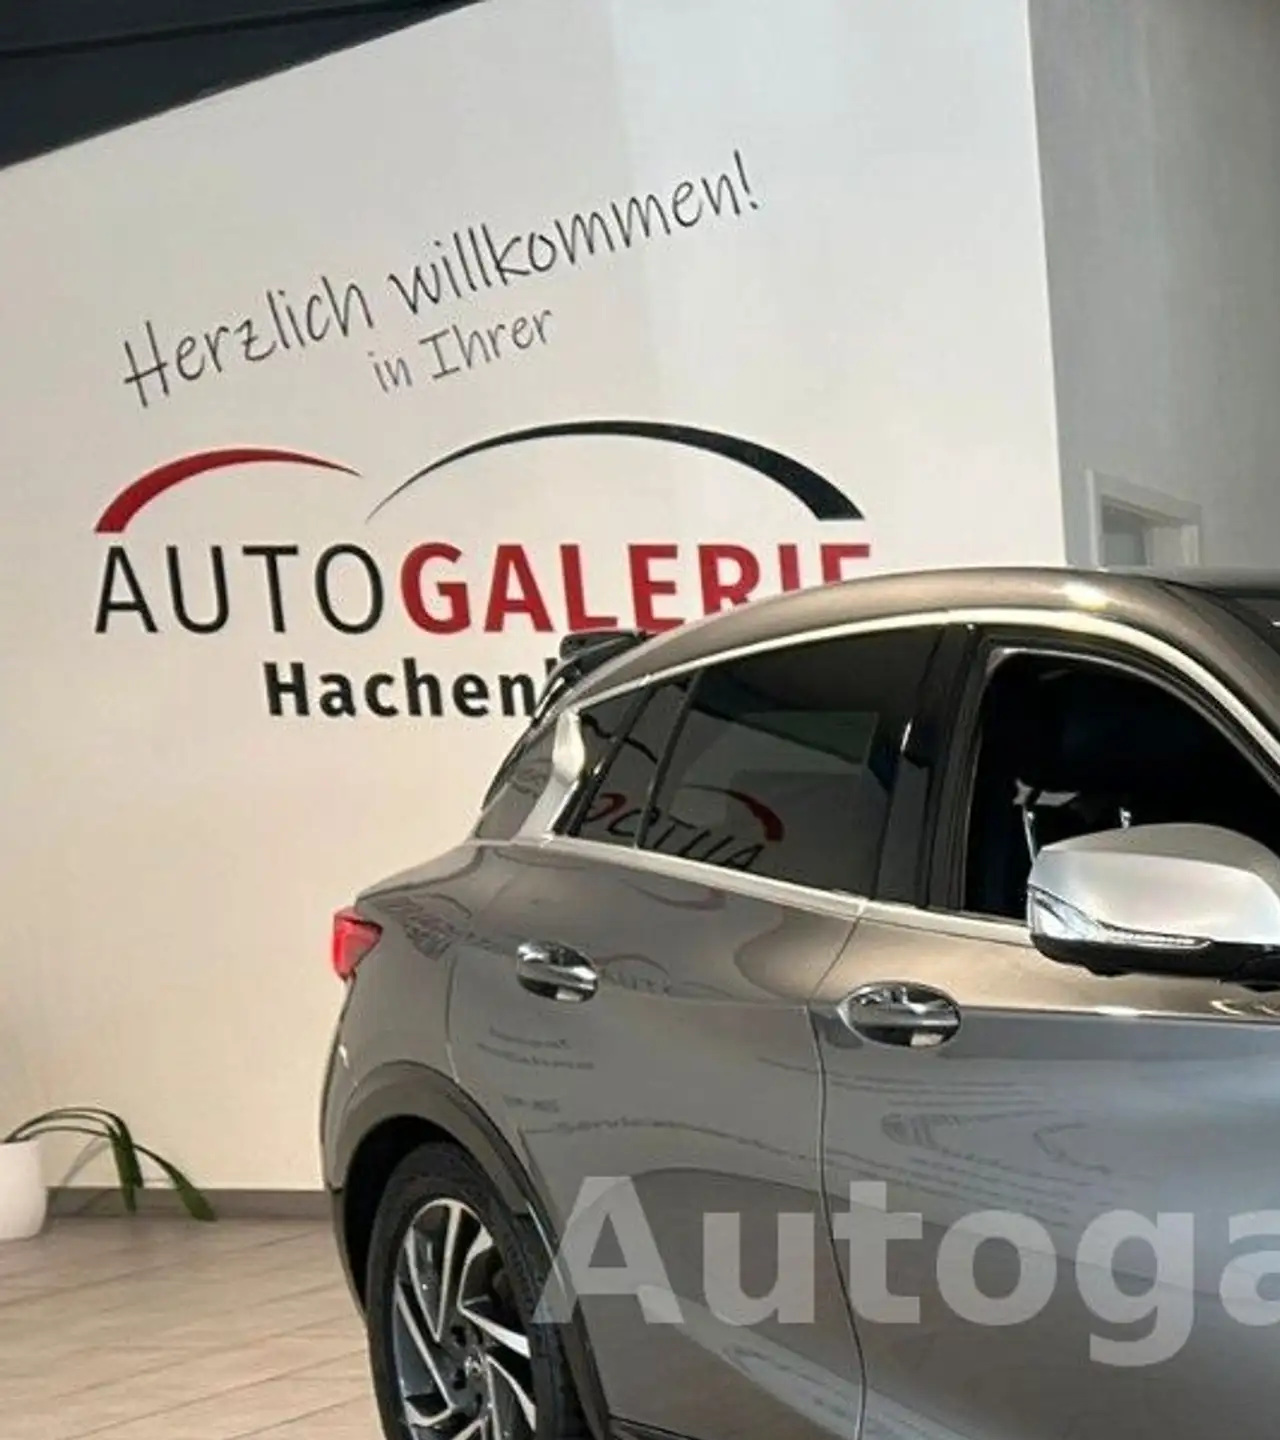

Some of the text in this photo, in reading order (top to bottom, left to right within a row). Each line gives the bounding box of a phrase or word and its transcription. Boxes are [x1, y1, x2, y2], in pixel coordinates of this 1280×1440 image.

[122, 149, 761, 407] Herzlich willkommen!
[370, 305, 555, 394] in Ihrer
